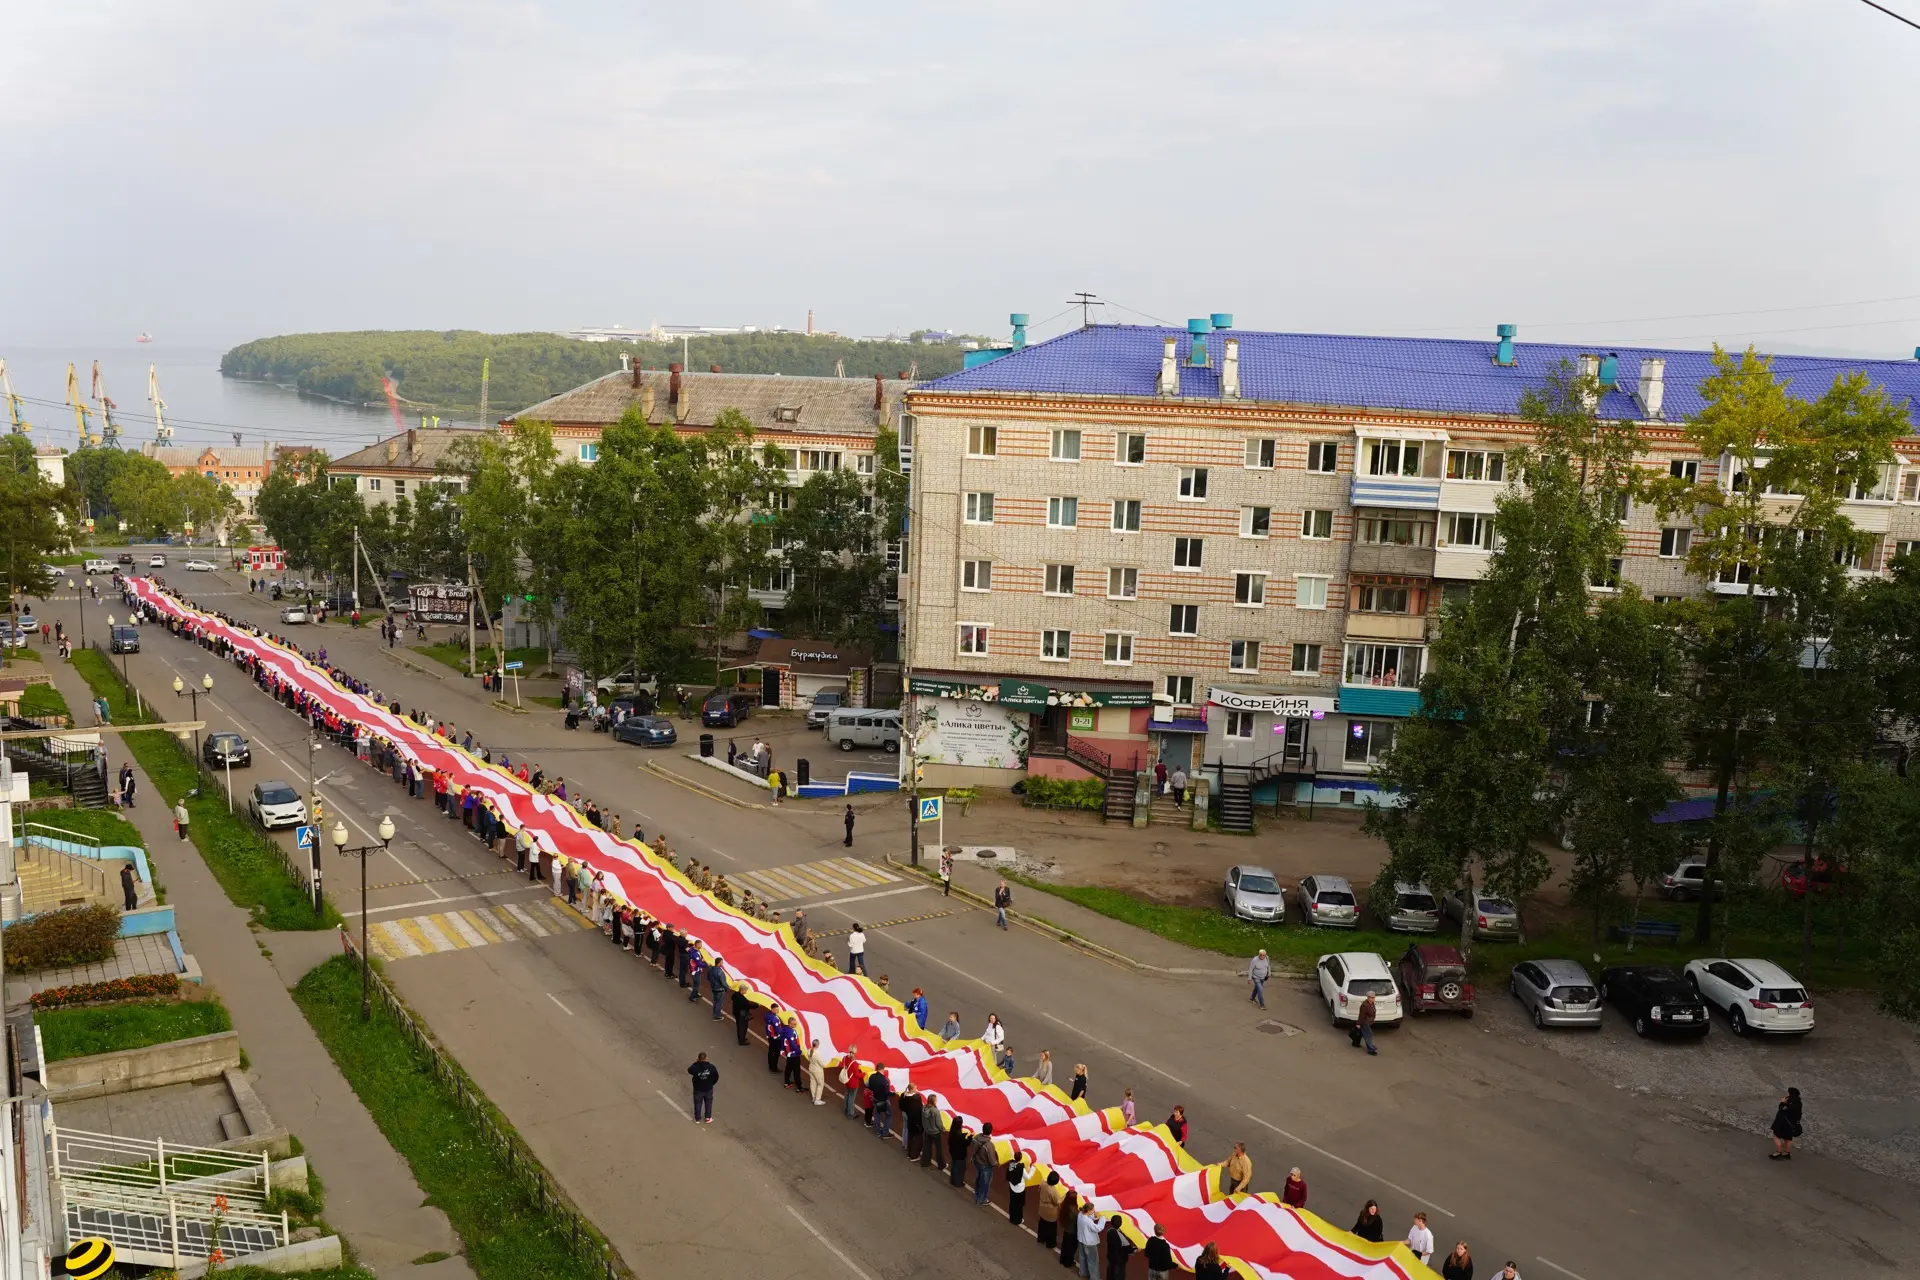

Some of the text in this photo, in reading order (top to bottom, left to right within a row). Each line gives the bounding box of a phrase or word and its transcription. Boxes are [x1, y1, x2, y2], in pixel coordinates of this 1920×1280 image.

[1220, 694, 1309, 710] КОФЕЙНЯ
[940, 720, 972, 729] «Алика
[974, 722, 1006, 731] цветы»
